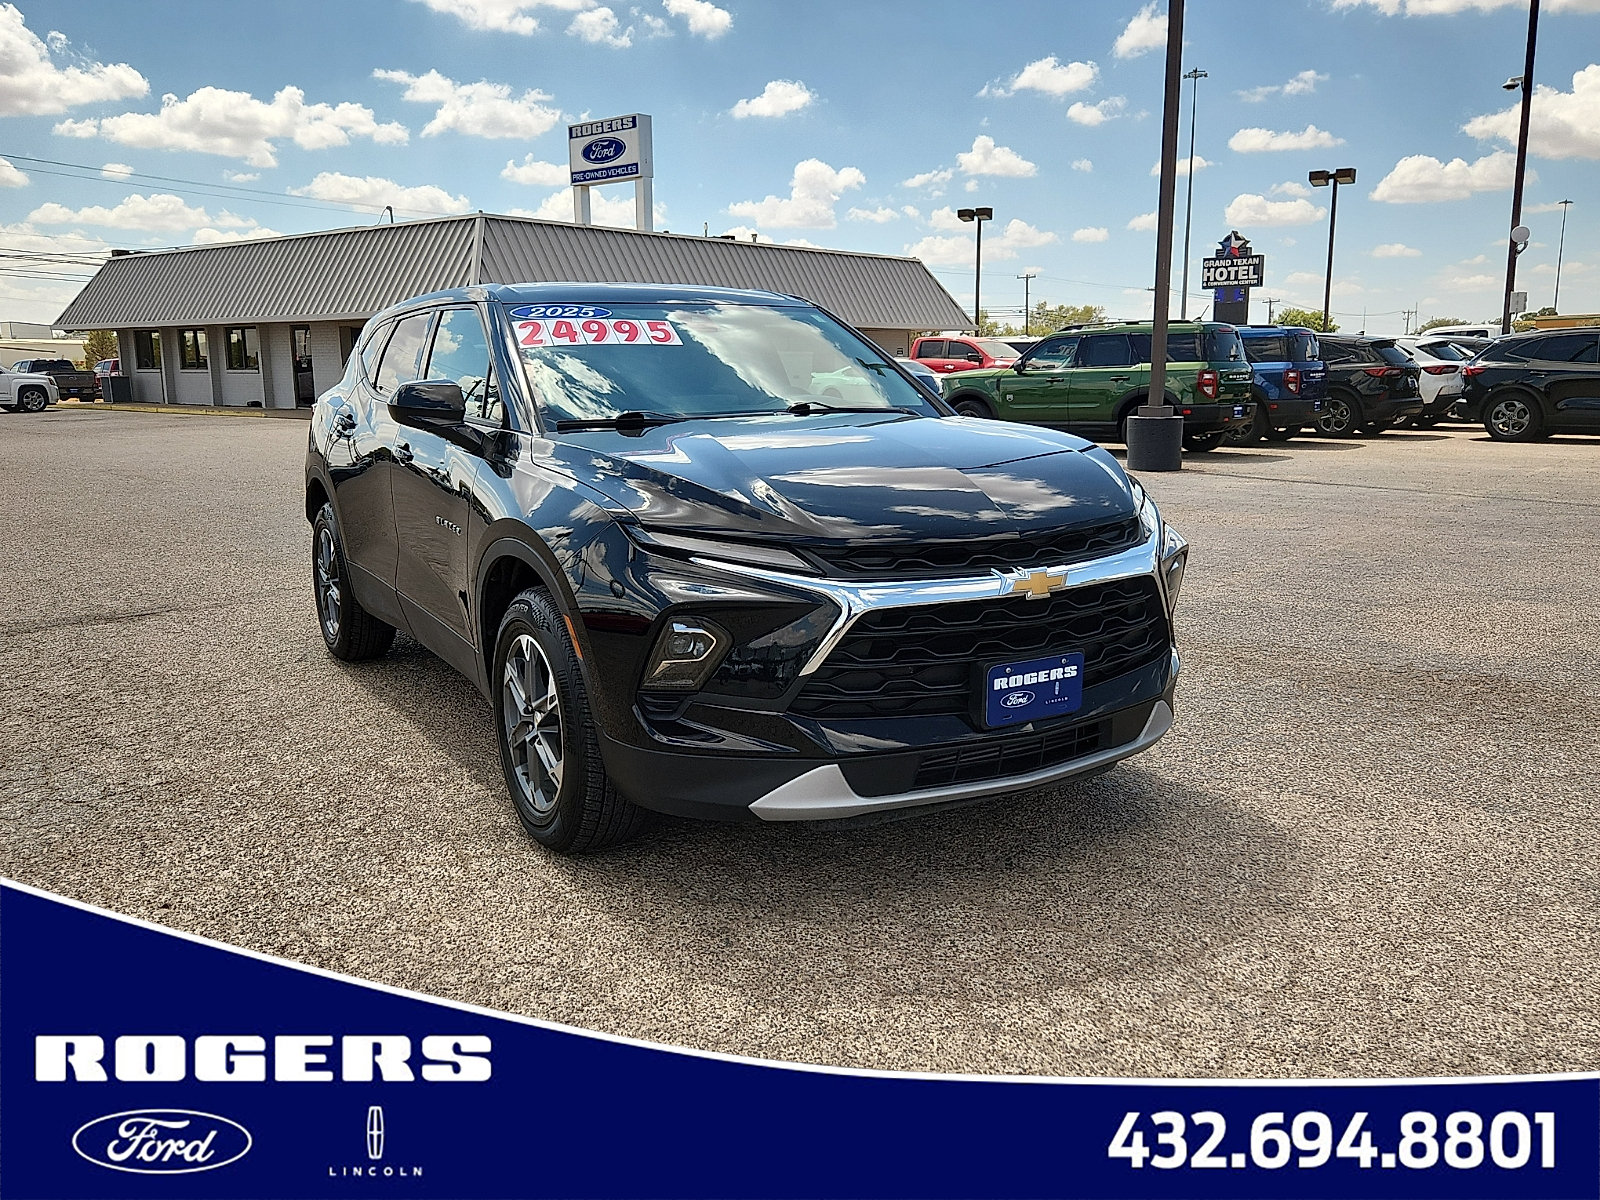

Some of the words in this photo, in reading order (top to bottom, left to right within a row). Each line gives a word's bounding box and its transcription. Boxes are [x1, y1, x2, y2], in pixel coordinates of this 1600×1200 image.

[572, 117, 633, 137] ROGERS
[590, 141, 615, 159] Ford
[573, 170, 607, 181] PRE-OWNED
[608, 165, 636, 175] VEHICLES
[1233, 257, 1260, 265] TEXAN
[1203, 266, 1259, 282] HOTEL
[528, 307, 596, 317] 2025
[518, 320, 676, 346] 24995
[993, 665, 1078, 691] ROGERS
[1006, 693, 1029, 706] Ford
